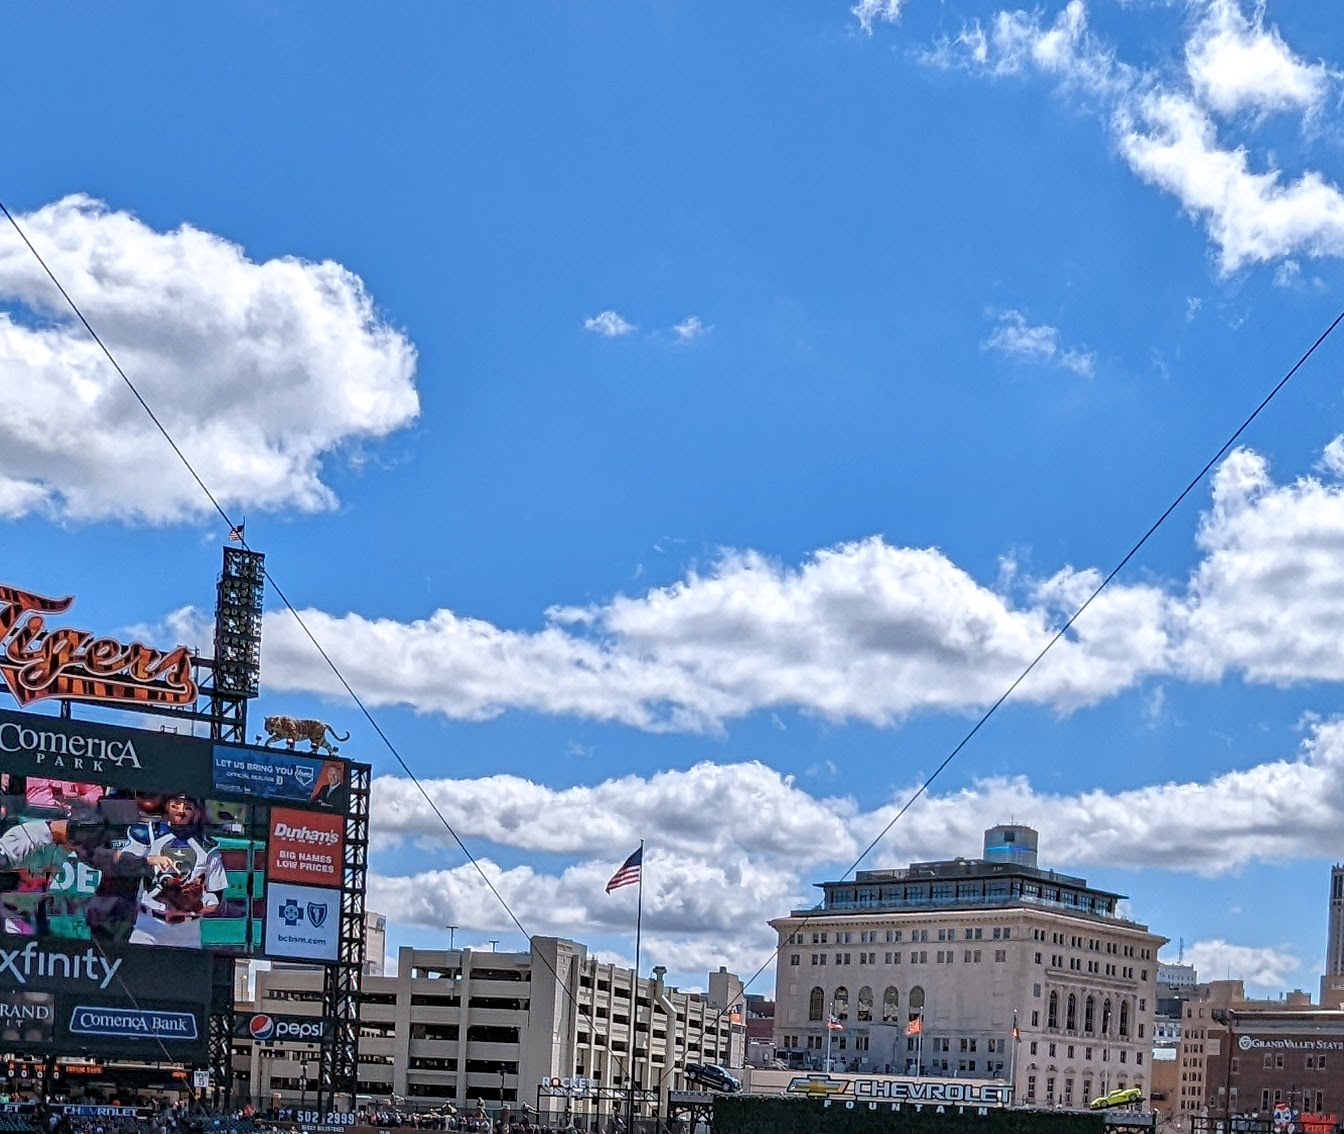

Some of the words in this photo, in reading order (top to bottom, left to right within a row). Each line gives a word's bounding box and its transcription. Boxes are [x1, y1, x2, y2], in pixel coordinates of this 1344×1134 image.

[35, 753, 104, 772] PARK
[216, 759, 232, 768] LET
[233, 761, 245, 769] US
[246, 763, 273, 773] BRING
[274, 766, 293, 776] YOU
[274, 822, 339, 844] Dunham's
[279, 850, 296, 860] BIG
[298, 852, 332, 864] NAMES
[276, 859, 298, 869] LOW
[299, 862, 335, 874] PRICES
[151, 1016, 188, 1032] Bank
[276, 1021, 324, 1039] pepsi
[1251, 1038, 1285, 1049] GRAND
[1284, 1040, 1316, 1050] VALLEY
[1315, 1040, 1344, 1050] STATE
[541, 1076, 595, 1089] ROCKET
[855, 1079, 1014, 1103] CHEVROLET
[63, 1105, 138, 1117] CHEVROLET
[823, 1100, 988, 1116] FOUNTAIN
[297, 1110, 319, 1123] 502
[326, 1111, 355, 1126] 2999
